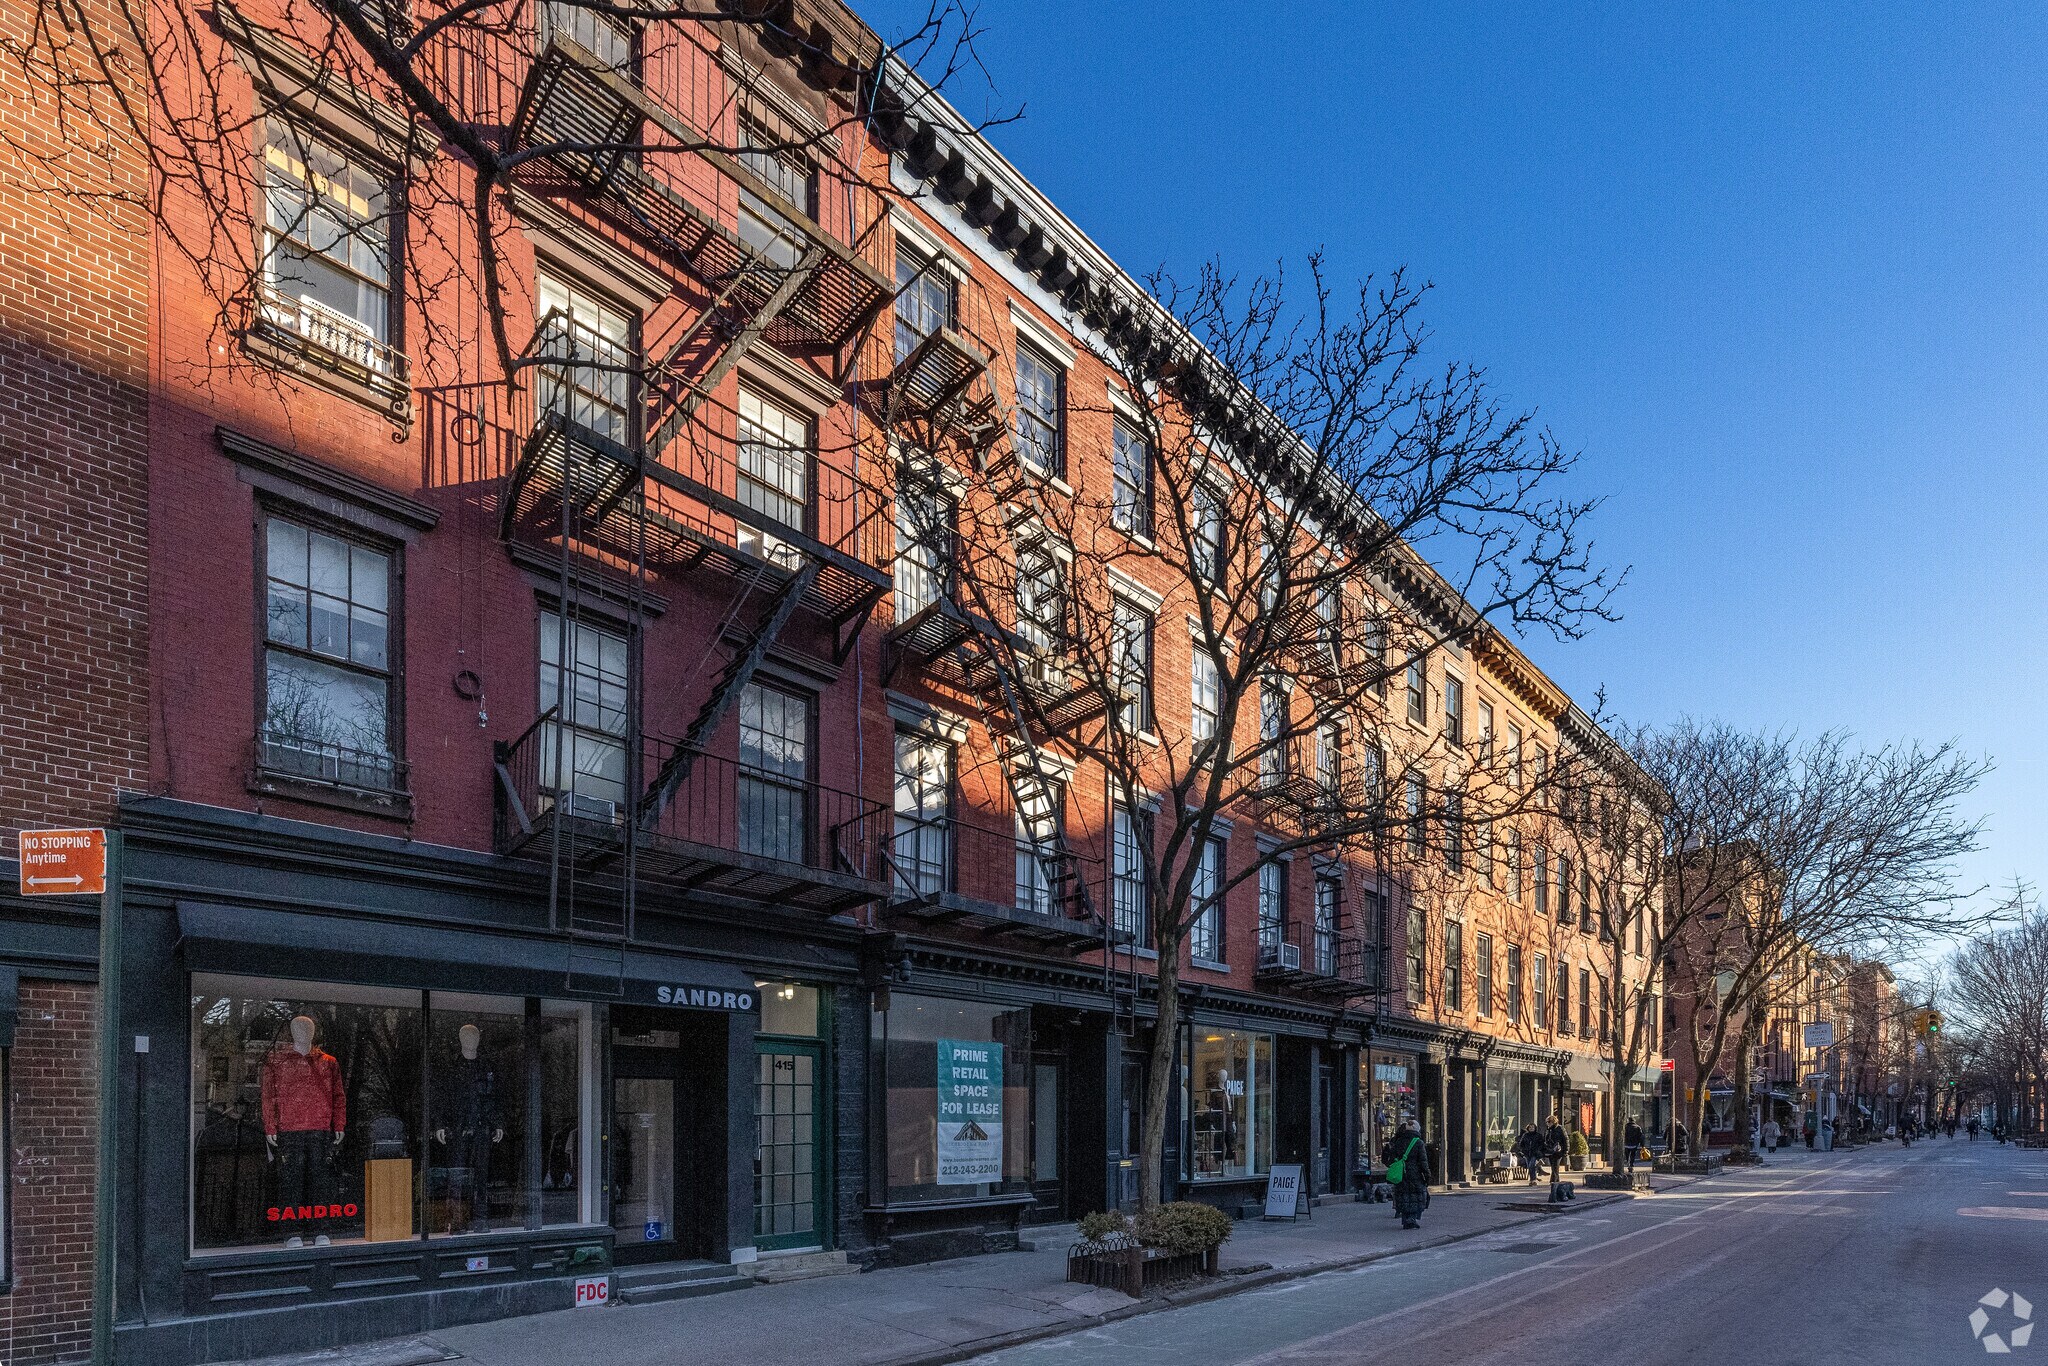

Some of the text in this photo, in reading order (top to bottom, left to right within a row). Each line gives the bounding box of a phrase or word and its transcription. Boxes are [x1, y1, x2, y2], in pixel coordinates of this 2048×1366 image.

[24, 836, 91, 849] NO STOPPING
[25, 852, 67, 866] Anytime
[657, 986, 753, 1010] SANDRO
[953, 1048, 988, 1062] PRIME
[775, 1060, 793, 1070] 415
[952, 1067, 989, 1080] RETAIL
[953, 1084, 988, 1097] SPACE
[1226, 1080, 1244, 1095] PAIGE
[941, 1102, 999, 1115] FOR LEASE
[1273, 1176, 1296, 1189] PAIGE
[1271, 1194, 1294, 1203] SALE
[267, 1203, 358, 1221] SANDRO
[577, 1282, 607, 1301] FDC
